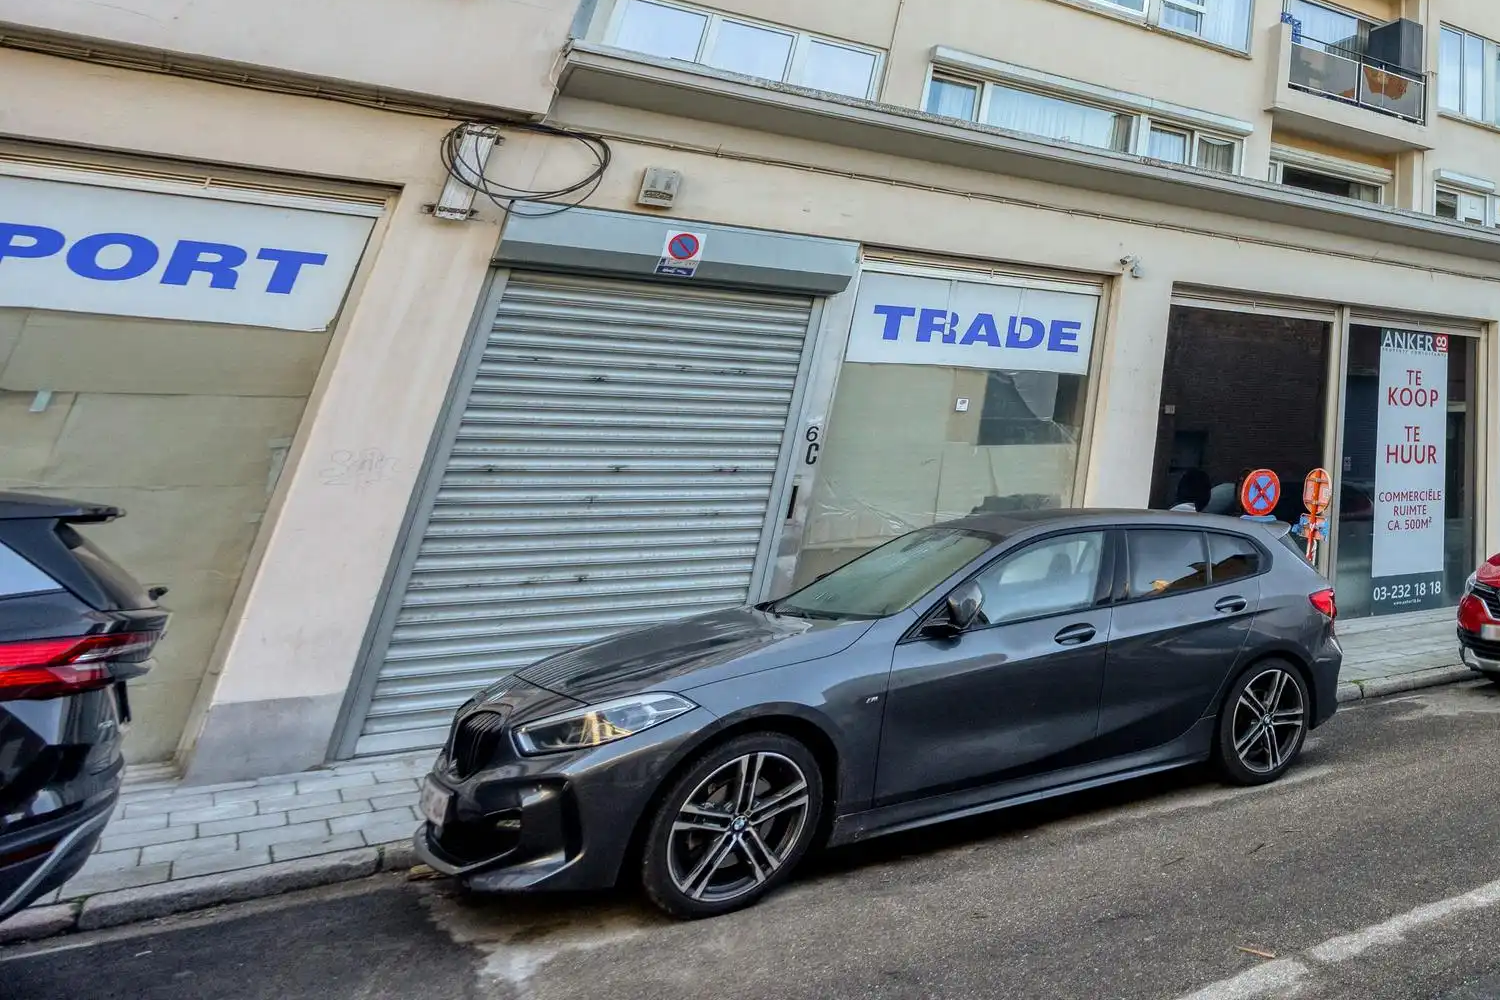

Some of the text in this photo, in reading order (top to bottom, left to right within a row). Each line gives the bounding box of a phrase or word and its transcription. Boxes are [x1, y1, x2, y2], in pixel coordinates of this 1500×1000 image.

[0, 222, 328, 295] PORT
[873, 304, 1082, 353] TRADE
[1383, 331, 1433, 352] ANKER
[1406, 370, 1421, 385] TE
[1388, 387, 1438, 407] KOOP
[1405, 426, 1420, 442] TE
[1387, 445, 1436, 464] HUUR
[1379, 489, 1441, 502] COMMERCIËLE
[1393, 505, 1427, 516] RUIMTE
[1387, 520, 1402, 531] CA.
[1373, 580, 1441, 601] 03-232 18 18
